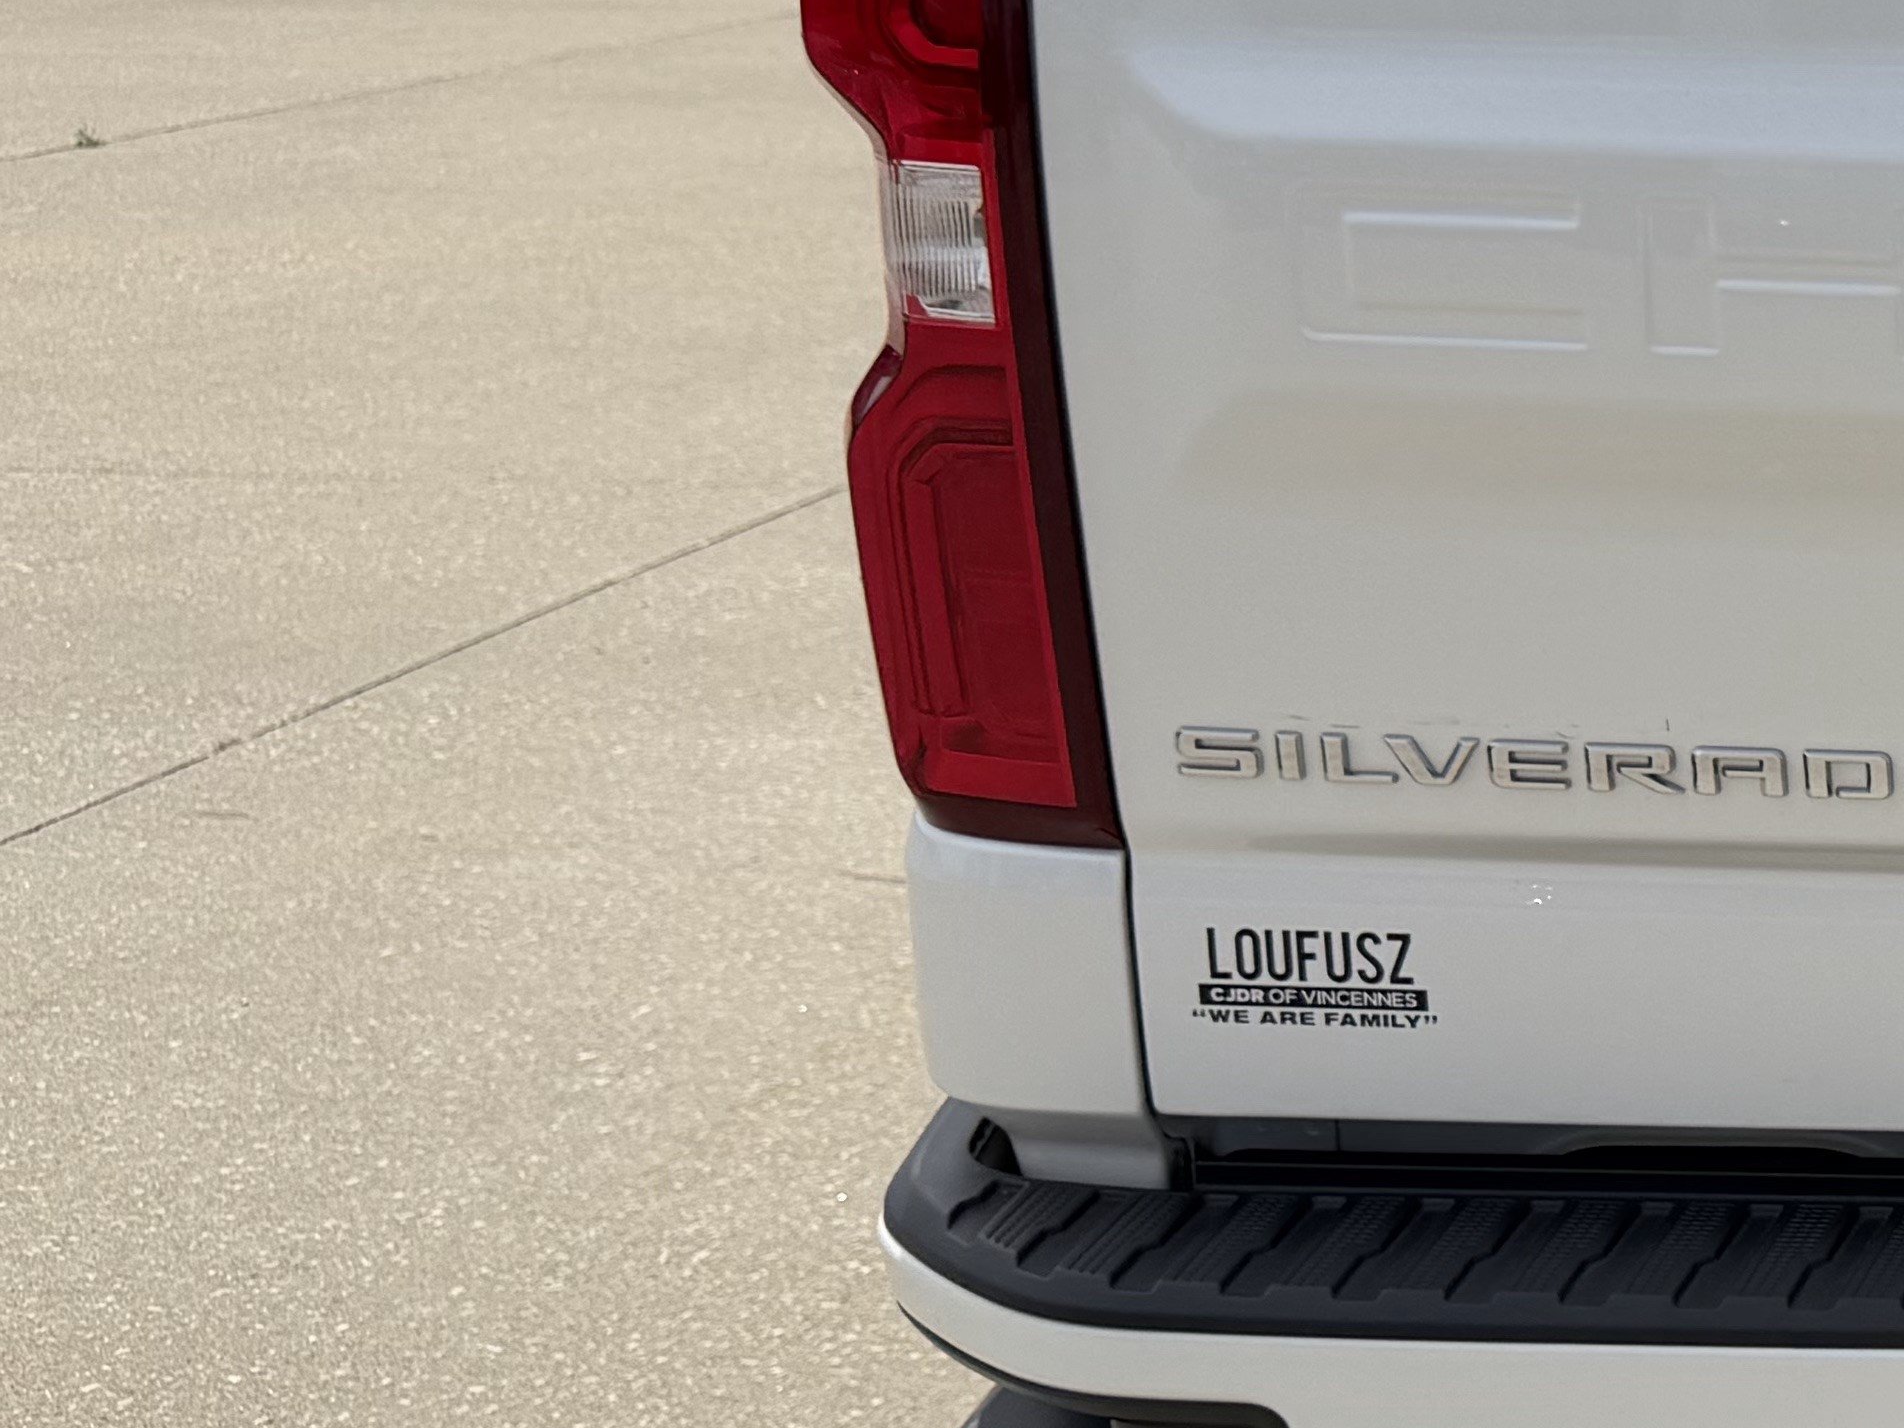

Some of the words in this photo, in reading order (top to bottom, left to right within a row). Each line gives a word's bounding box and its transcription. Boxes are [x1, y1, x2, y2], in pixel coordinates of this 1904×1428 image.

[1210, 987, 1265, 1004] CJDR
[1268, 988, 1297, 1005] OF
[1301, 990, 1418, 1008] VINCENNES
[1260, 1010, 1315, 1026] ARE
